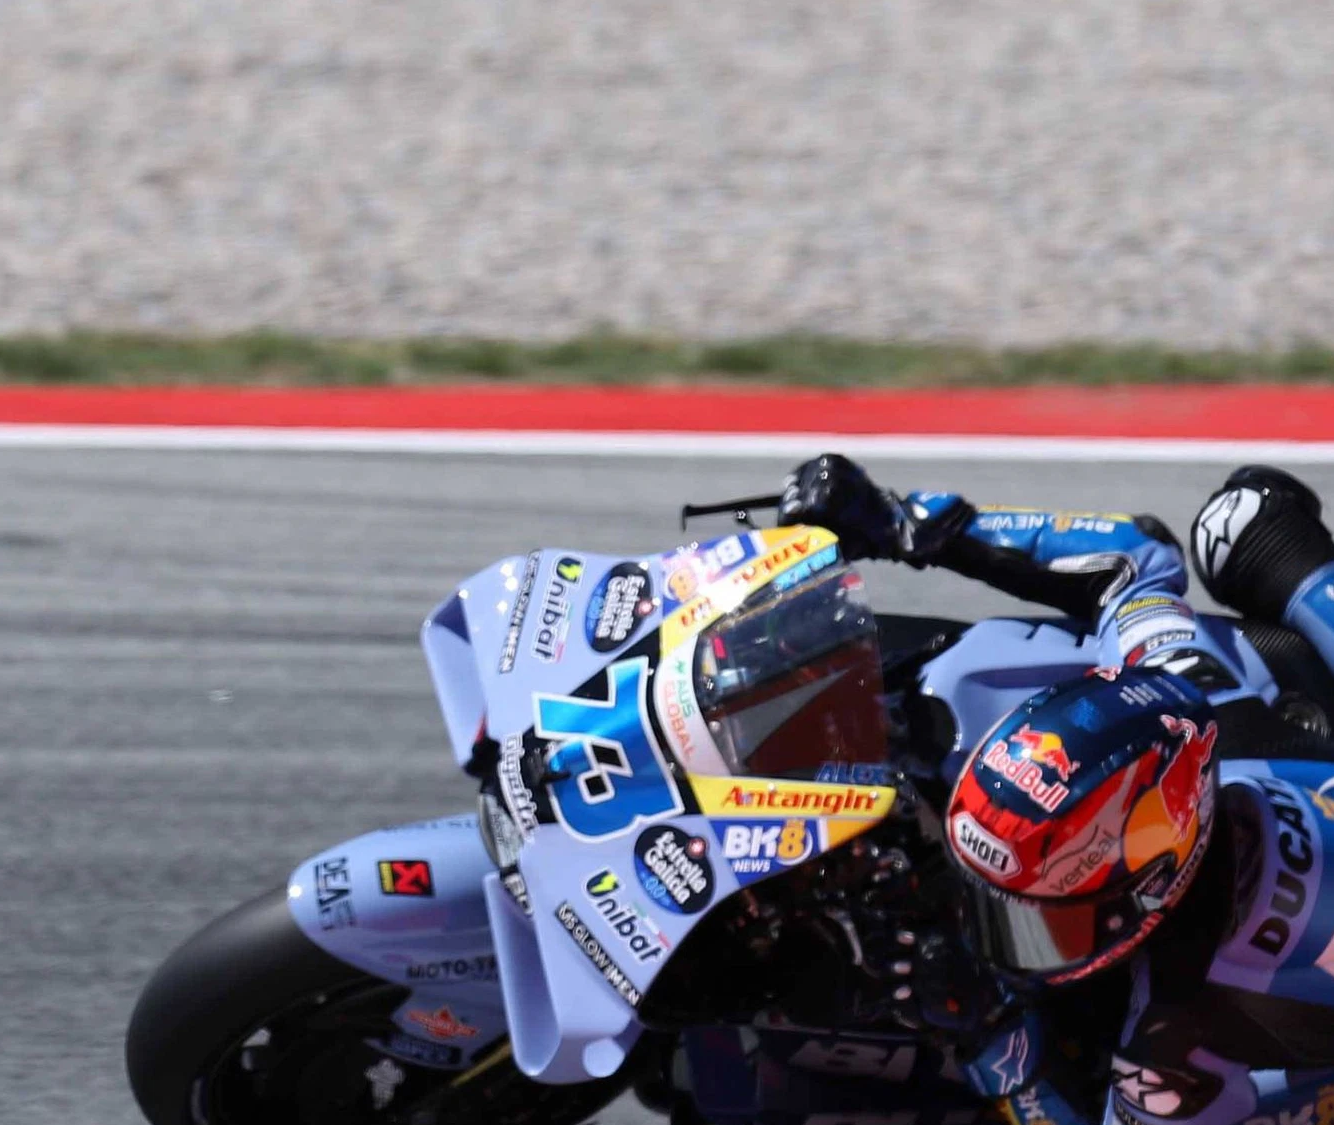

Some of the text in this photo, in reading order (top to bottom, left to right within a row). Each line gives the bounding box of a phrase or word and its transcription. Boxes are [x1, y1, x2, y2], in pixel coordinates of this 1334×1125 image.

[723, 786, 875, 815] Antangin
[656, 831, 707, 894] Estrella
[723, 820, 810, 864] BK8
[960, 823, 1009, 871] SHOEI
[644, 847, 690, 904] Galicia
[732, 859, 771, 874] NEWS
[586, 870, 662, 962] Unibat
